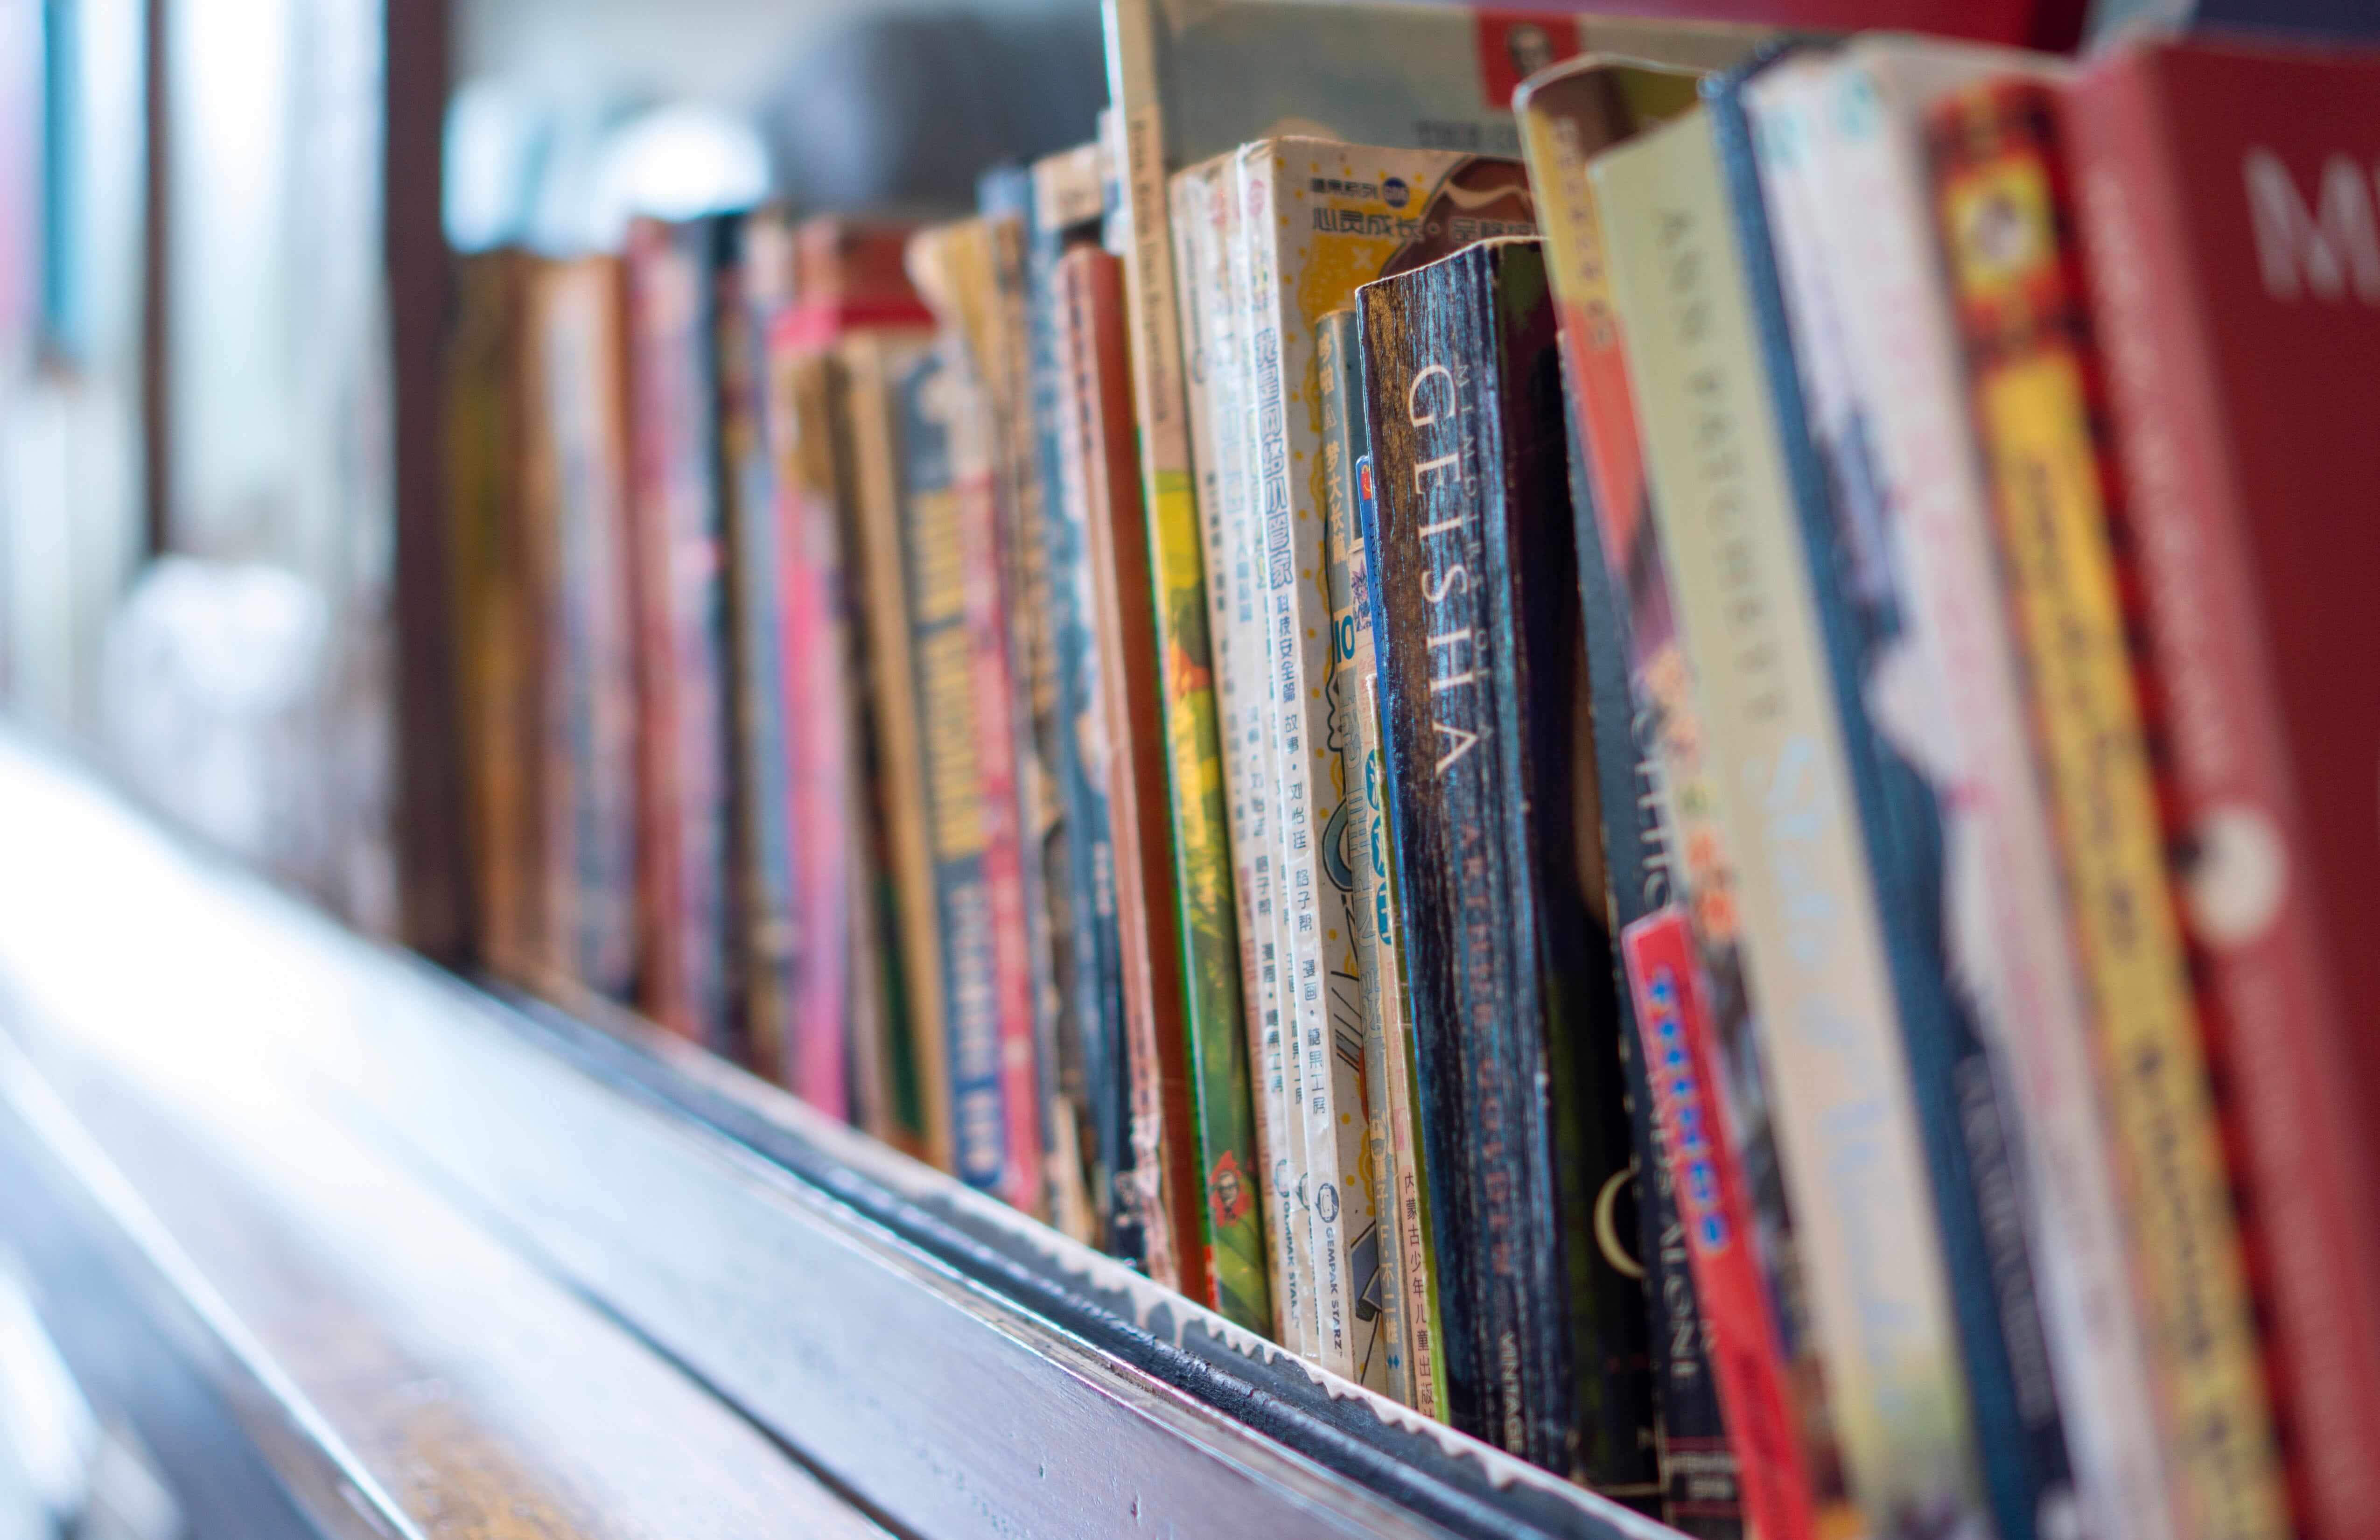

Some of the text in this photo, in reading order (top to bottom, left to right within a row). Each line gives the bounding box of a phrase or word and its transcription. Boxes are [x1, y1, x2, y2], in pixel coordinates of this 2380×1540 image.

[2242, 142, 2380, 308] M
[1408, 364, 1479, 778] GEISHA
[1335, 615, 1355, 664] 10
[1325, 1227, 1343, 1350] GEMPAK STARZ
[1498, 1330, 1524, 1454] VINTAGE
